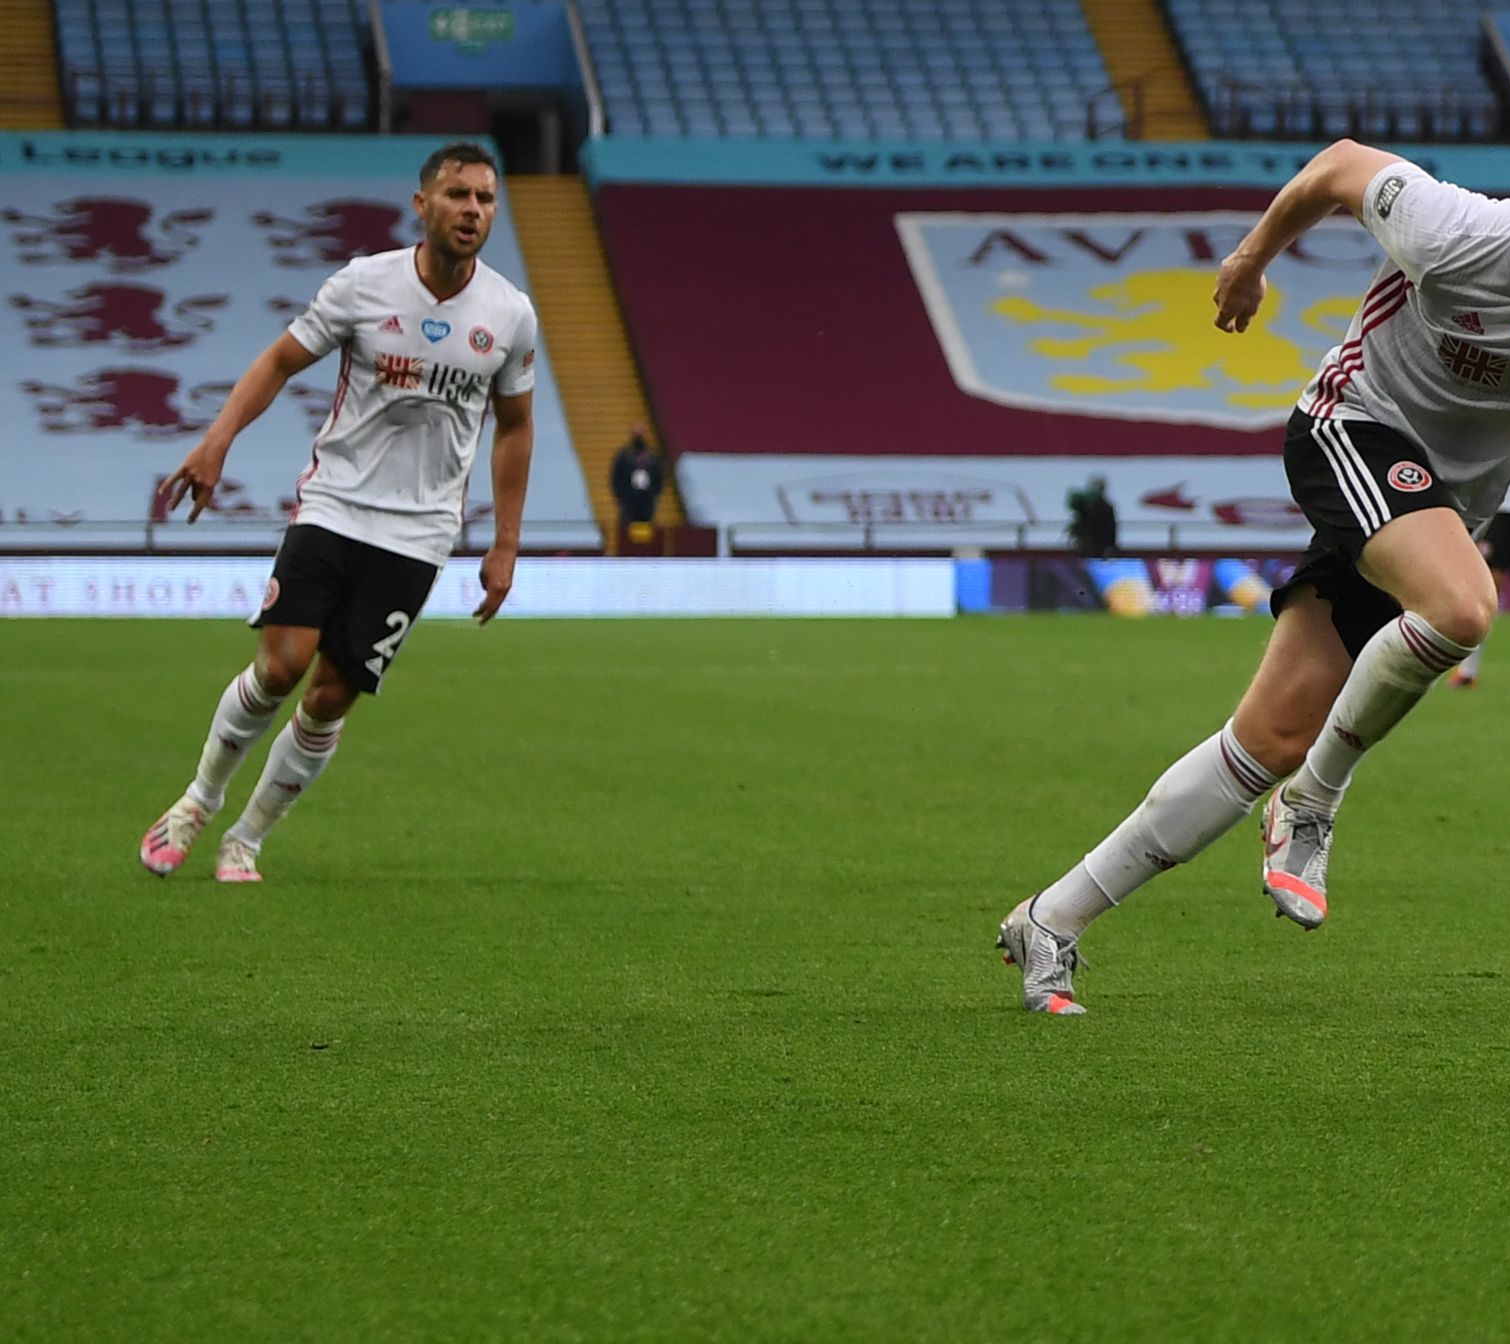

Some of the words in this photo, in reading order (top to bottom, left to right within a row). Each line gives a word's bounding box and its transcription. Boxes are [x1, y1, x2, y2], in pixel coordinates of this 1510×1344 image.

[22, 140, 282, 167] League
[819, 150, 927, 172] WE
[943, 150, 1075, 172] ARE
[1092, 151, 1235, 173] ONE
[371, 610, 411, 659] 2
